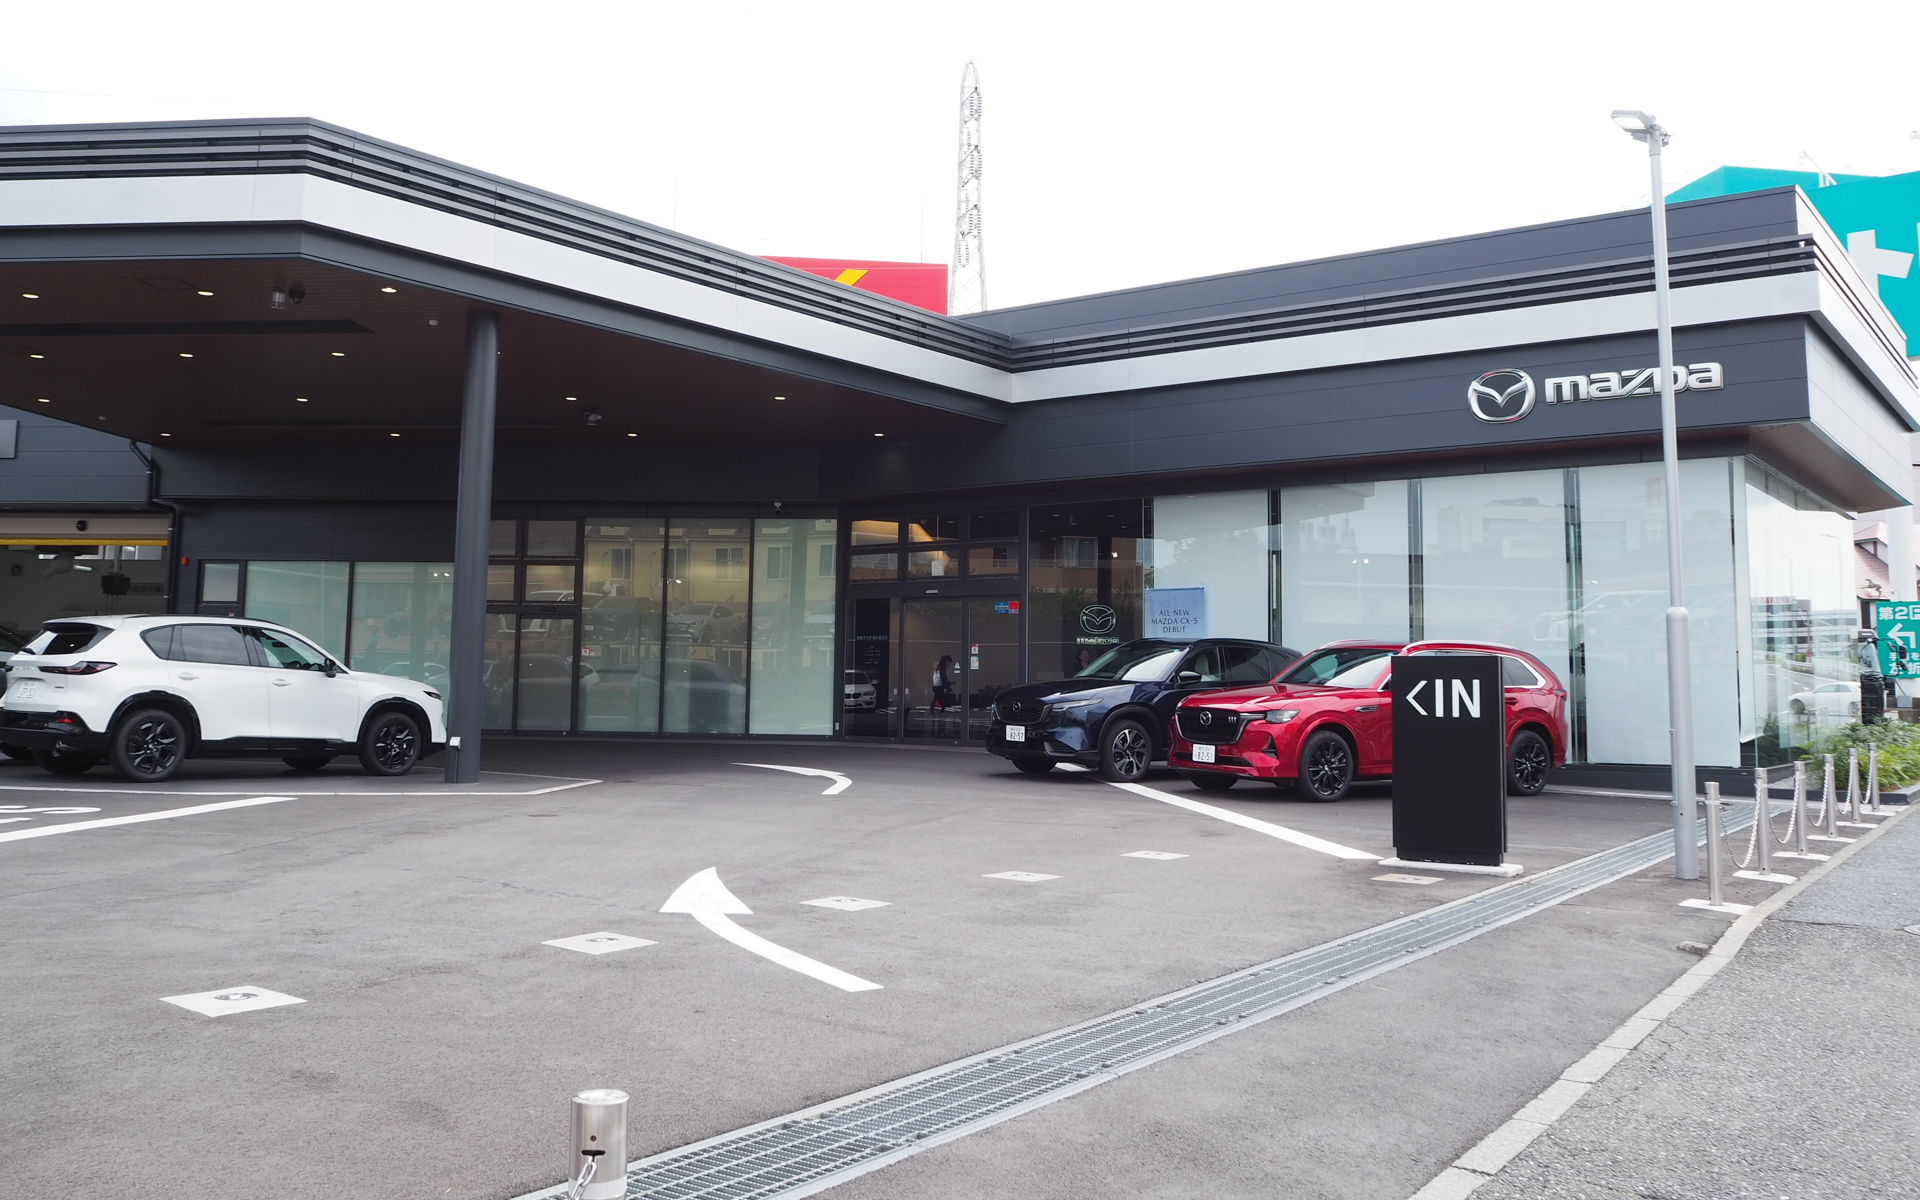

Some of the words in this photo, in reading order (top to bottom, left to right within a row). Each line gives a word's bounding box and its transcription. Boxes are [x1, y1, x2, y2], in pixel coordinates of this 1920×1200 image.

[1545, 362, 1723, 405] mazda
[1151, 617, 1178, 625] MAZDA
[1180, 617, 1198, 625] CX-5
[1435, 679, 1480, 718] IN
[1010, 732, 1024, 740] 82-57
[1197, 752, 1213, 761] 82-51
